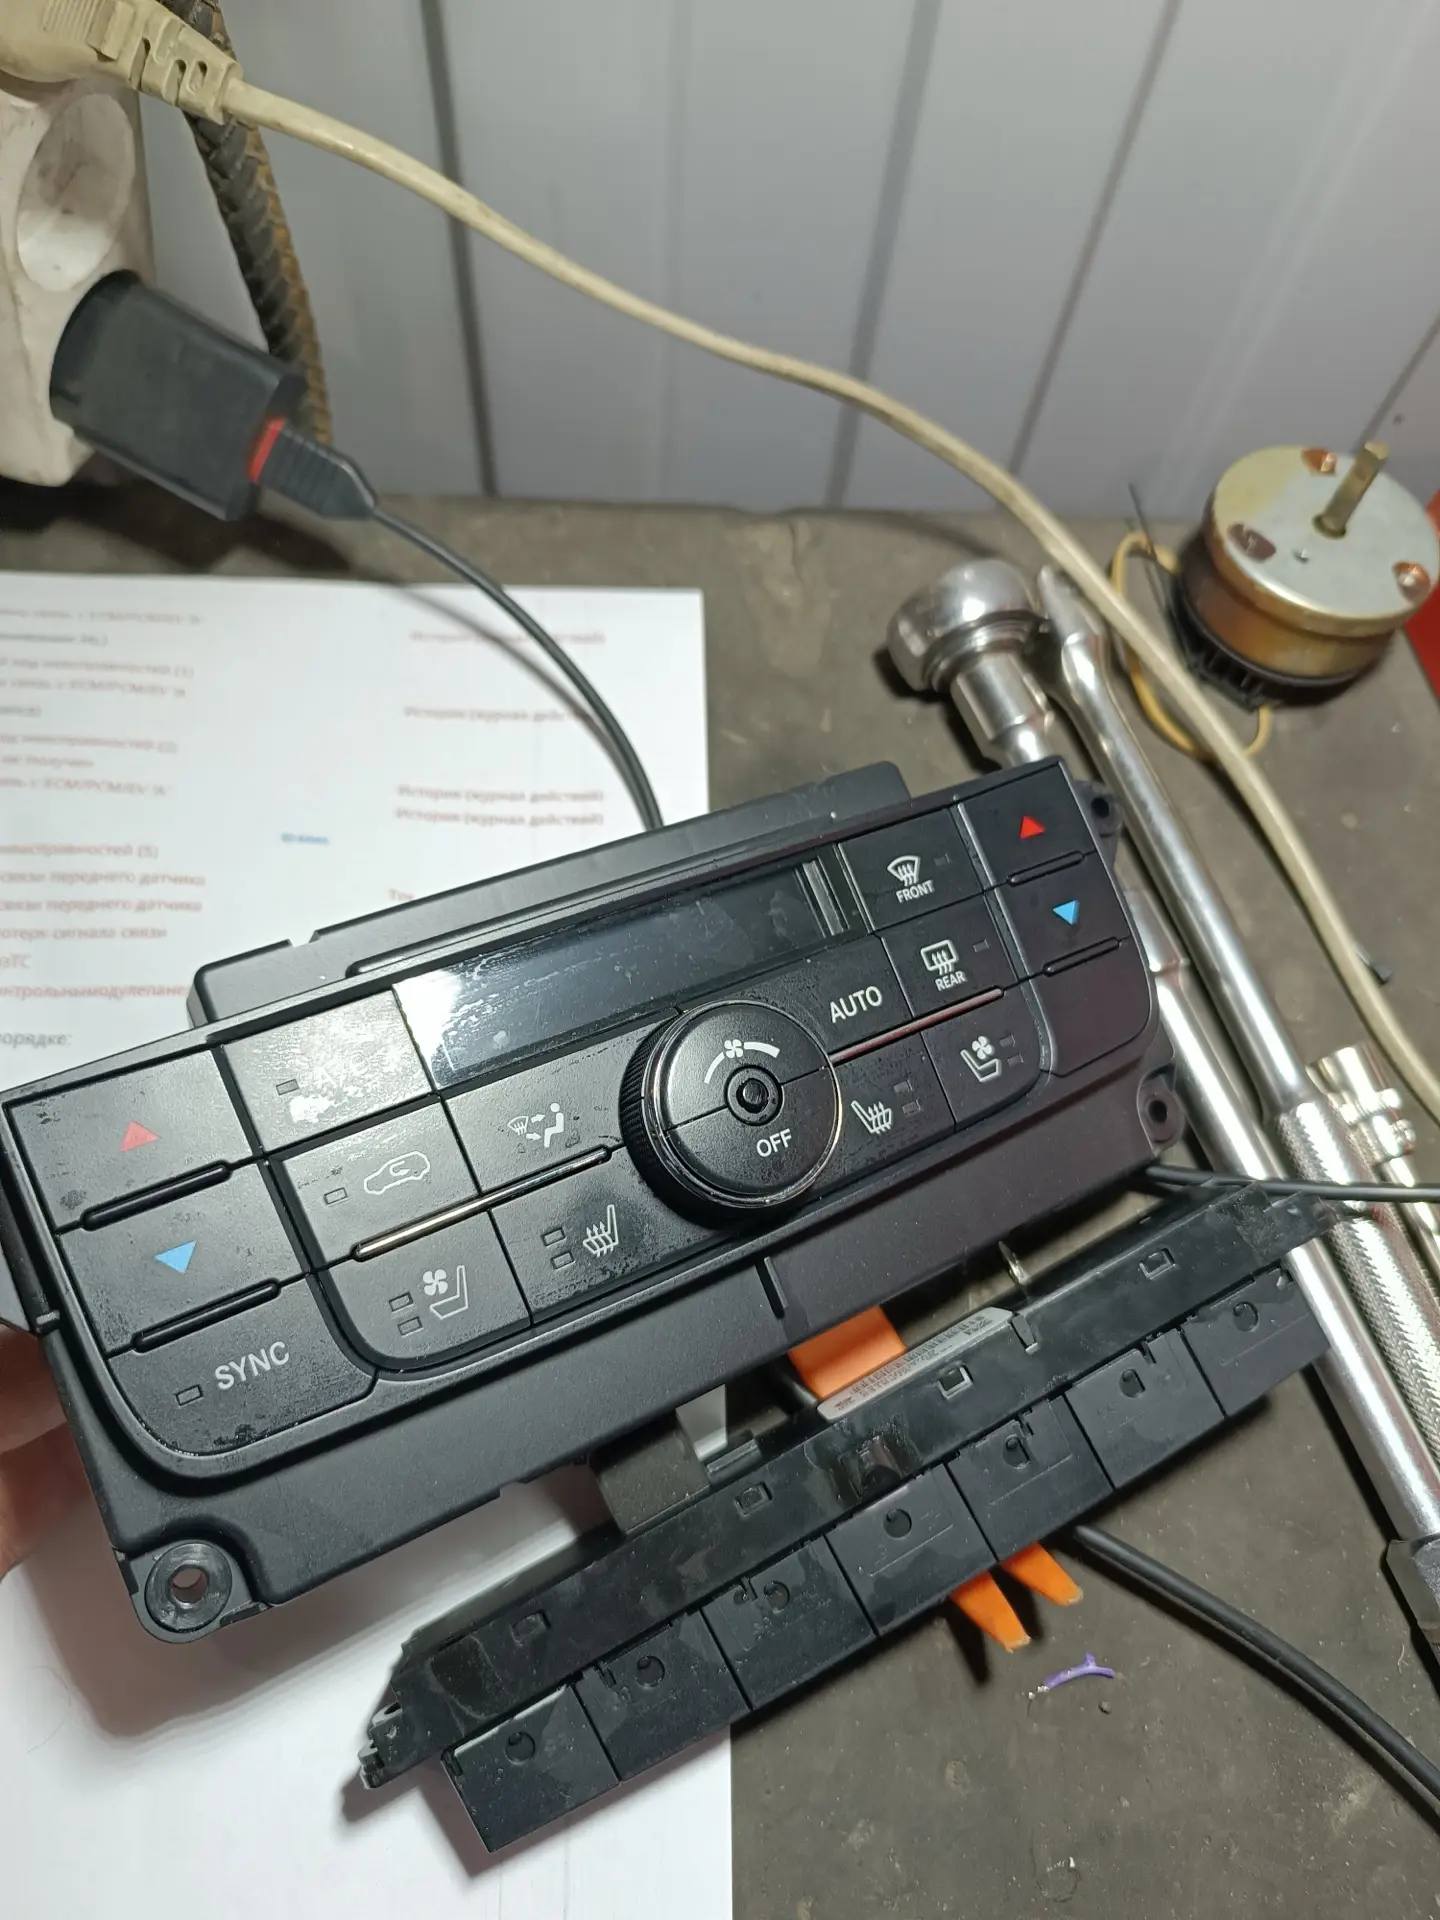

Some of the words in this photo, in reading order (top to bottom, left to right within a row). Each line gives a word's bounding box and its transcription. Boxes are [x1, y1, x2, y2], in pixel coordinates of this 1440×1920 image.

[896, 881, 934, 903] FRONT
[935, 972, 966, 991] REAR
[830, 986, 882, 1023] AUTO
[0, 1032, 73, 1049] орядке:
[756, 1128, 792, 1157] OFF
[214, 1341, 289, 1390] SYNC
